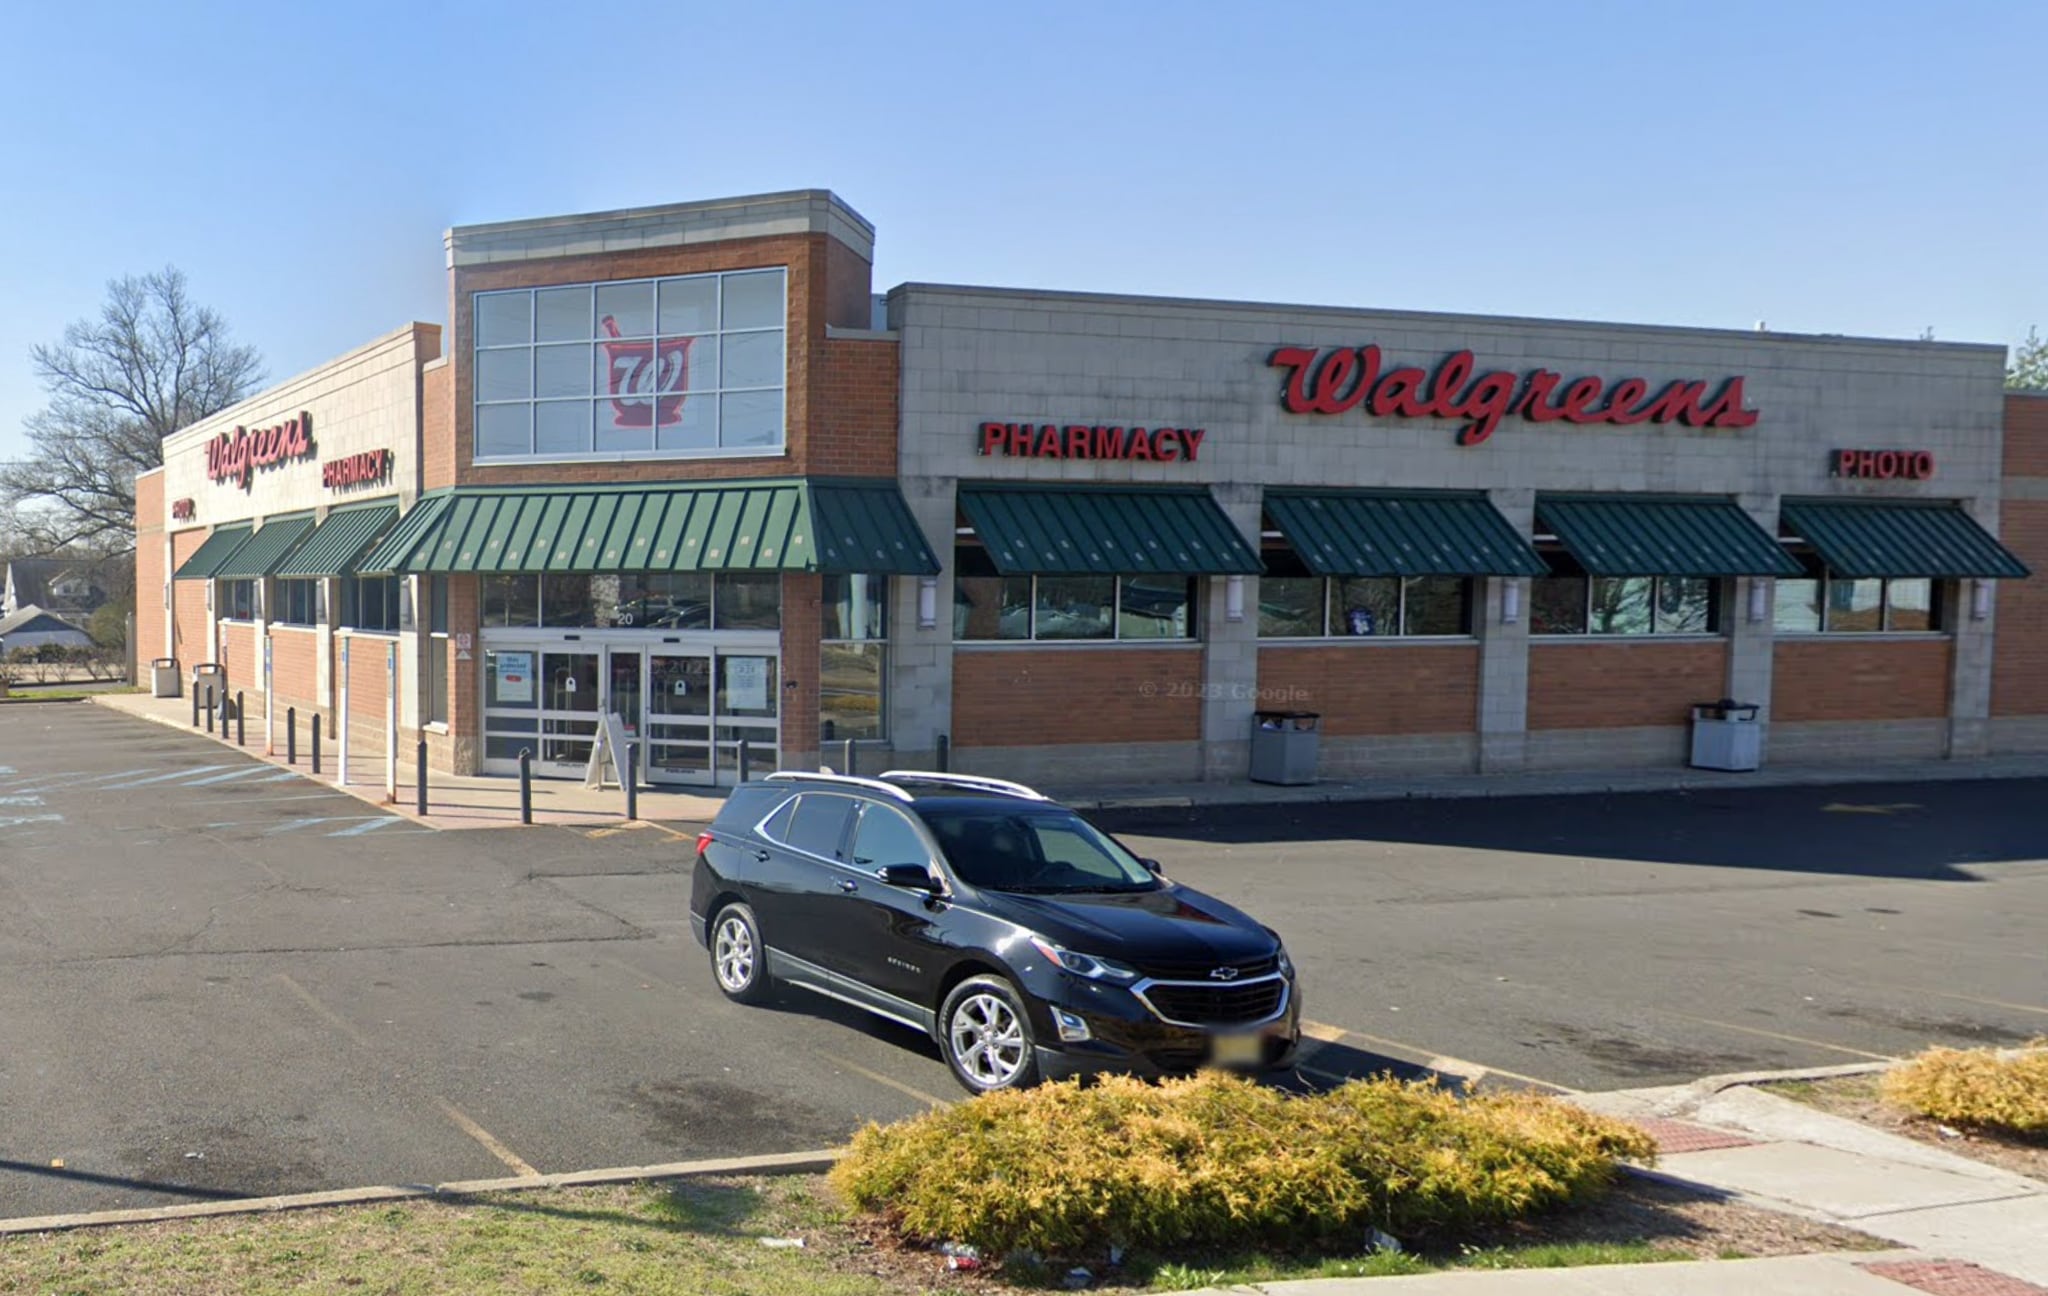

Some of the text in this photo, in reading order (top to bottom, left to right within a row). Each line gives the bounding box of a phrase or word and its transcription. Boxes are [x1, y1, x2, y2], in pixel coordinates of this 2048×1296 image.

[1267, 343, 1760, 446] Walgreens
[204, 410, 310, 490] Walgreens
[978, 422, 1205, 462] PHARMACY
[323, 448, 386, 488] PHARMACY
[1831, 449, 1936, 480] PHOTO
[617, 612, 634, 625] 20
